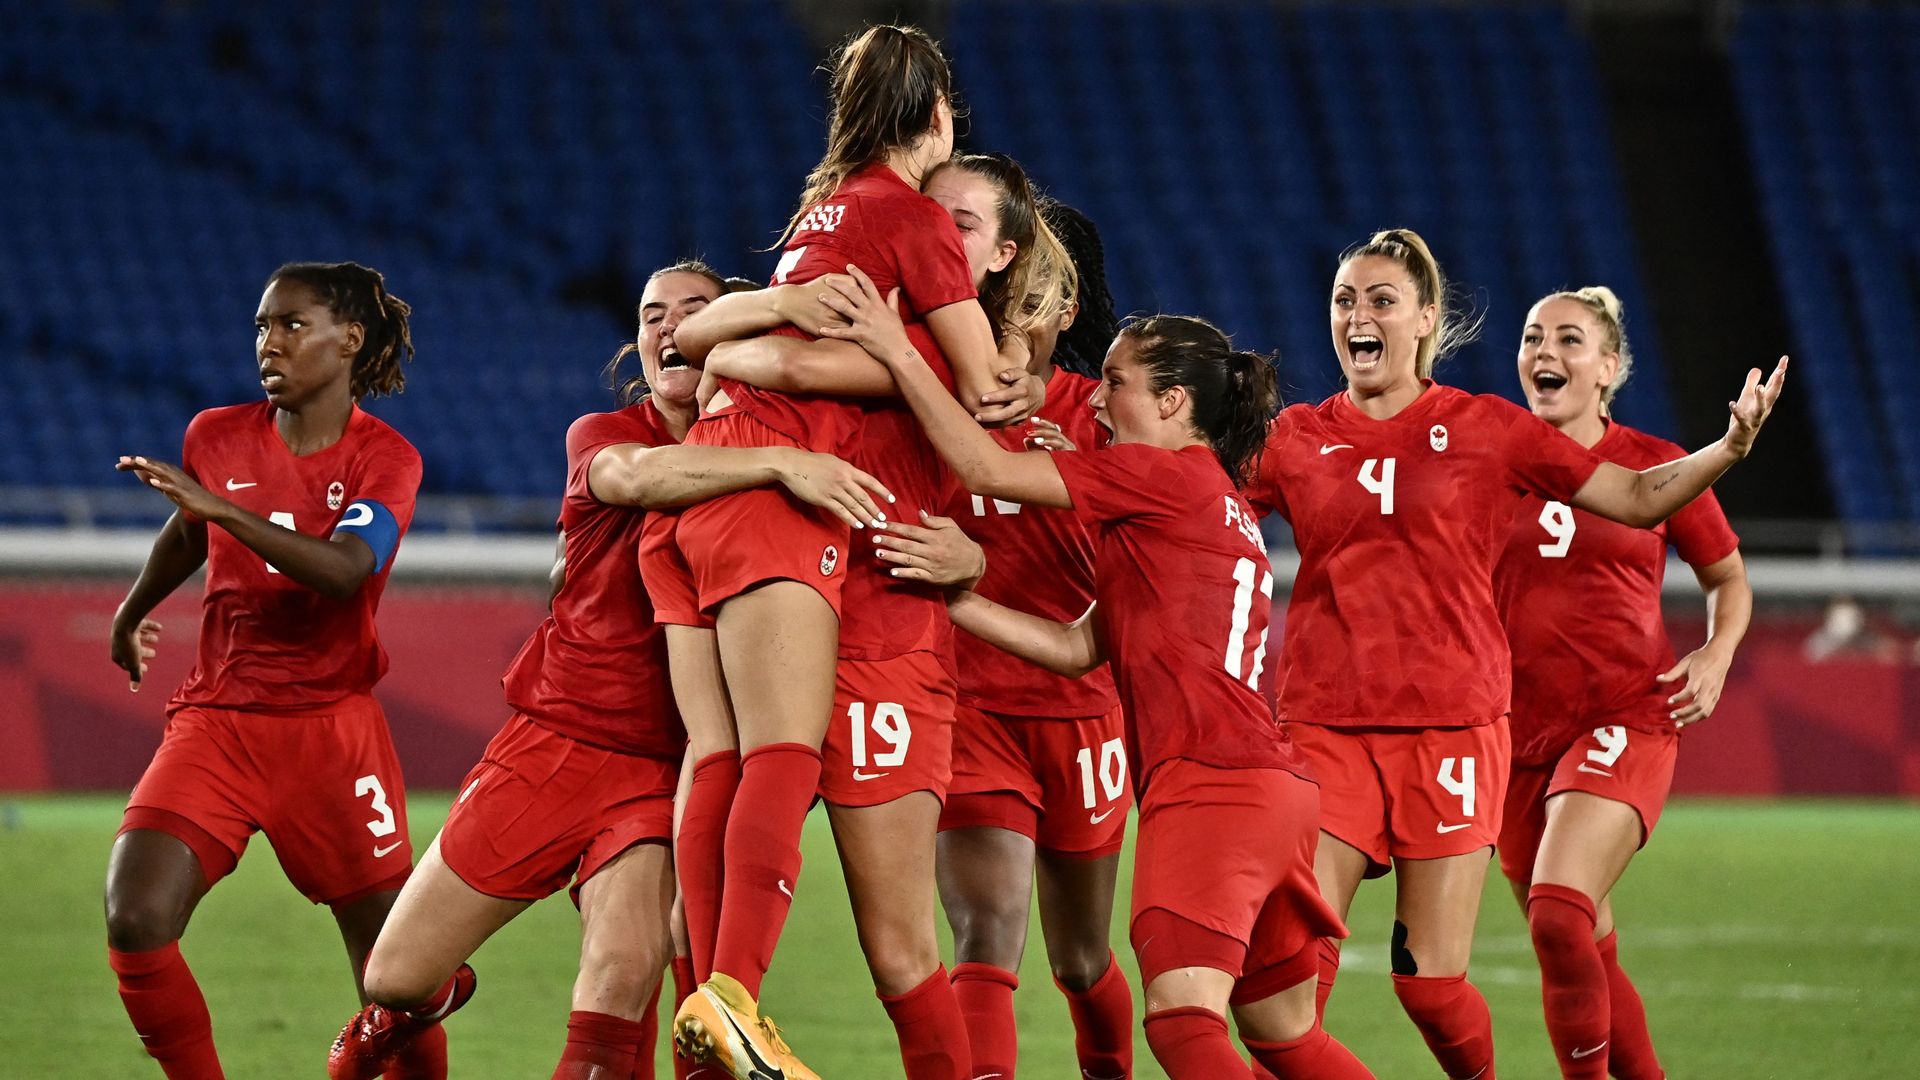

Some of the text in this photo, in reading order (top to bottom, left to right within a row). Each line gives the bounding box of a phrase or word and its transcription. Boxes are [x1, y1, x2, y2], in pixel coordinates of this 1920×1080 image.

[1357, 457, 1396, 515] 4
[1537, 500, 1577, 558] 9
[847, 702, 912, 767] 19
[1587, 725, 1628, 768] 9
[1076, 737, 1127, 809] 10
[1436, 757, 1476, 817] 4
[355, 774, 396, 838] 3
